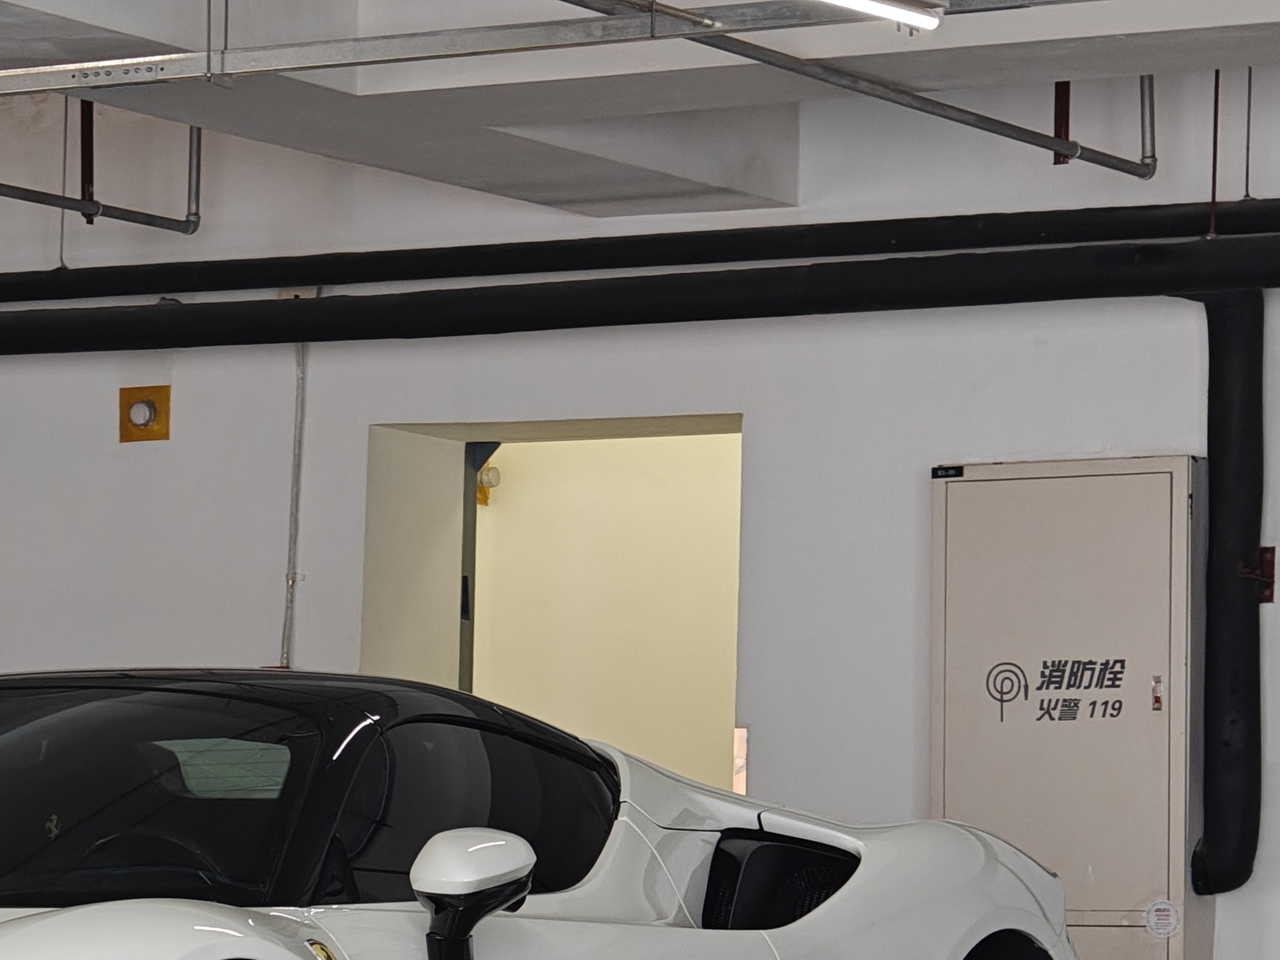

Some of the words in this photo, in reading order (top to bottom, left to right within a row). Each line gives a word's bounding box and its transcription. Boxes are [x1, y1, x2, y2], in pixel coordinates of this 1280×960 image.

[1036, 659, 1126, 691] 消防栓
[1036, 698, 1081, 721] 火警
[1088, 700, 1123, 719] 119
